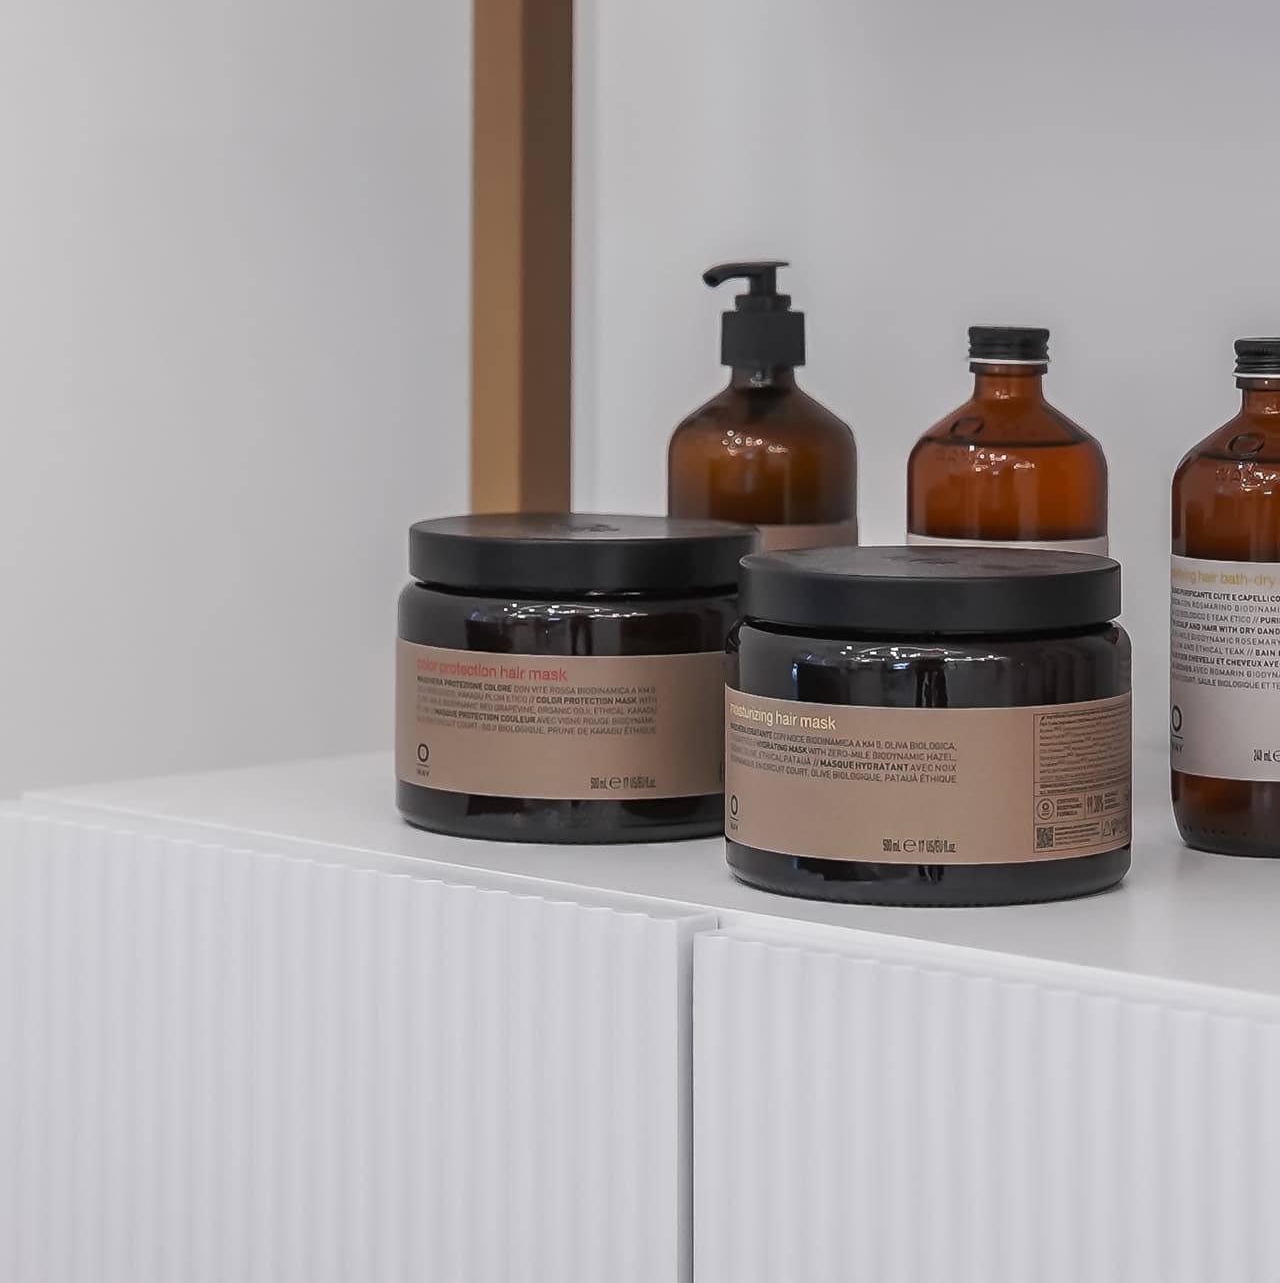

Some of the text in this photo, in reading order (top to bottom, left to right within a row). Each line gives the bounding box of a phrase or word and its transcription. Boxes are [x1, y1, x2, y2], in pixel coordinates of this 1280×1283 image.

[1221, 572, 1275, 588] bath-dry
[1213, 592, 1231, 601] CUTE
[1237, 593, 1270, 603] CAPELLI
[1212, 612, 1229, 622] TEAK
[1202, 622, 1218, 632] HAIR
[1219, 625, 1238, 634] WITH
[1239, 626, 1255, 635] DRY
[1225, 647, 1245, 656] TEAK
[1255, 649, 1276, 658] BAIN
[1216, 657, 1226, 666] ET
[1226, 658, 1262, 668] CHEVEUX
[439, 661, 497, 678] protection
[500, 664, 526, 679] hair
[527, 666, 568, 681] mask
[1209, 666, 1245, 678] ROMARIN
[444, 679, 483, 690] PROTEZIONE
[484, 681, 513, 692] COLORE
[548, 685, 577, 695] ROSSA
[1218, 678, 1260, 690] BIOLOGIQUE
[1261, 681, 1270, 690] ET
[536, 695, 637, 705] COLOR PROTECTION MASK
[459, 711, 500, 722] PROTECTION
[500, 714, 536, 724] COULEUR
[775, 711, 798, 728] hair
[800, 714, 837, 730] mask
[547, 726, 575, 736] PRUNE
[589, 726, 623, 736] KAKADU
[787, 733, 804, 744] NOCE
[884, 740, 908, 750] OLIVA
[909, 741, 956, 752] BIOLOGICA,
[417, 743, 430, 763] O
[789, 744, 925, 761] MASK WITH ZERO-MILE BIODYNAMIC
[819, 759, 956, 773] MASQUE HYDRATANT AVEC NOIX
[811, 768, 831, 779] OLIVE
[919, 772, 957, 784] ÉTHIQUE
[730, 794, 739, 816] O
